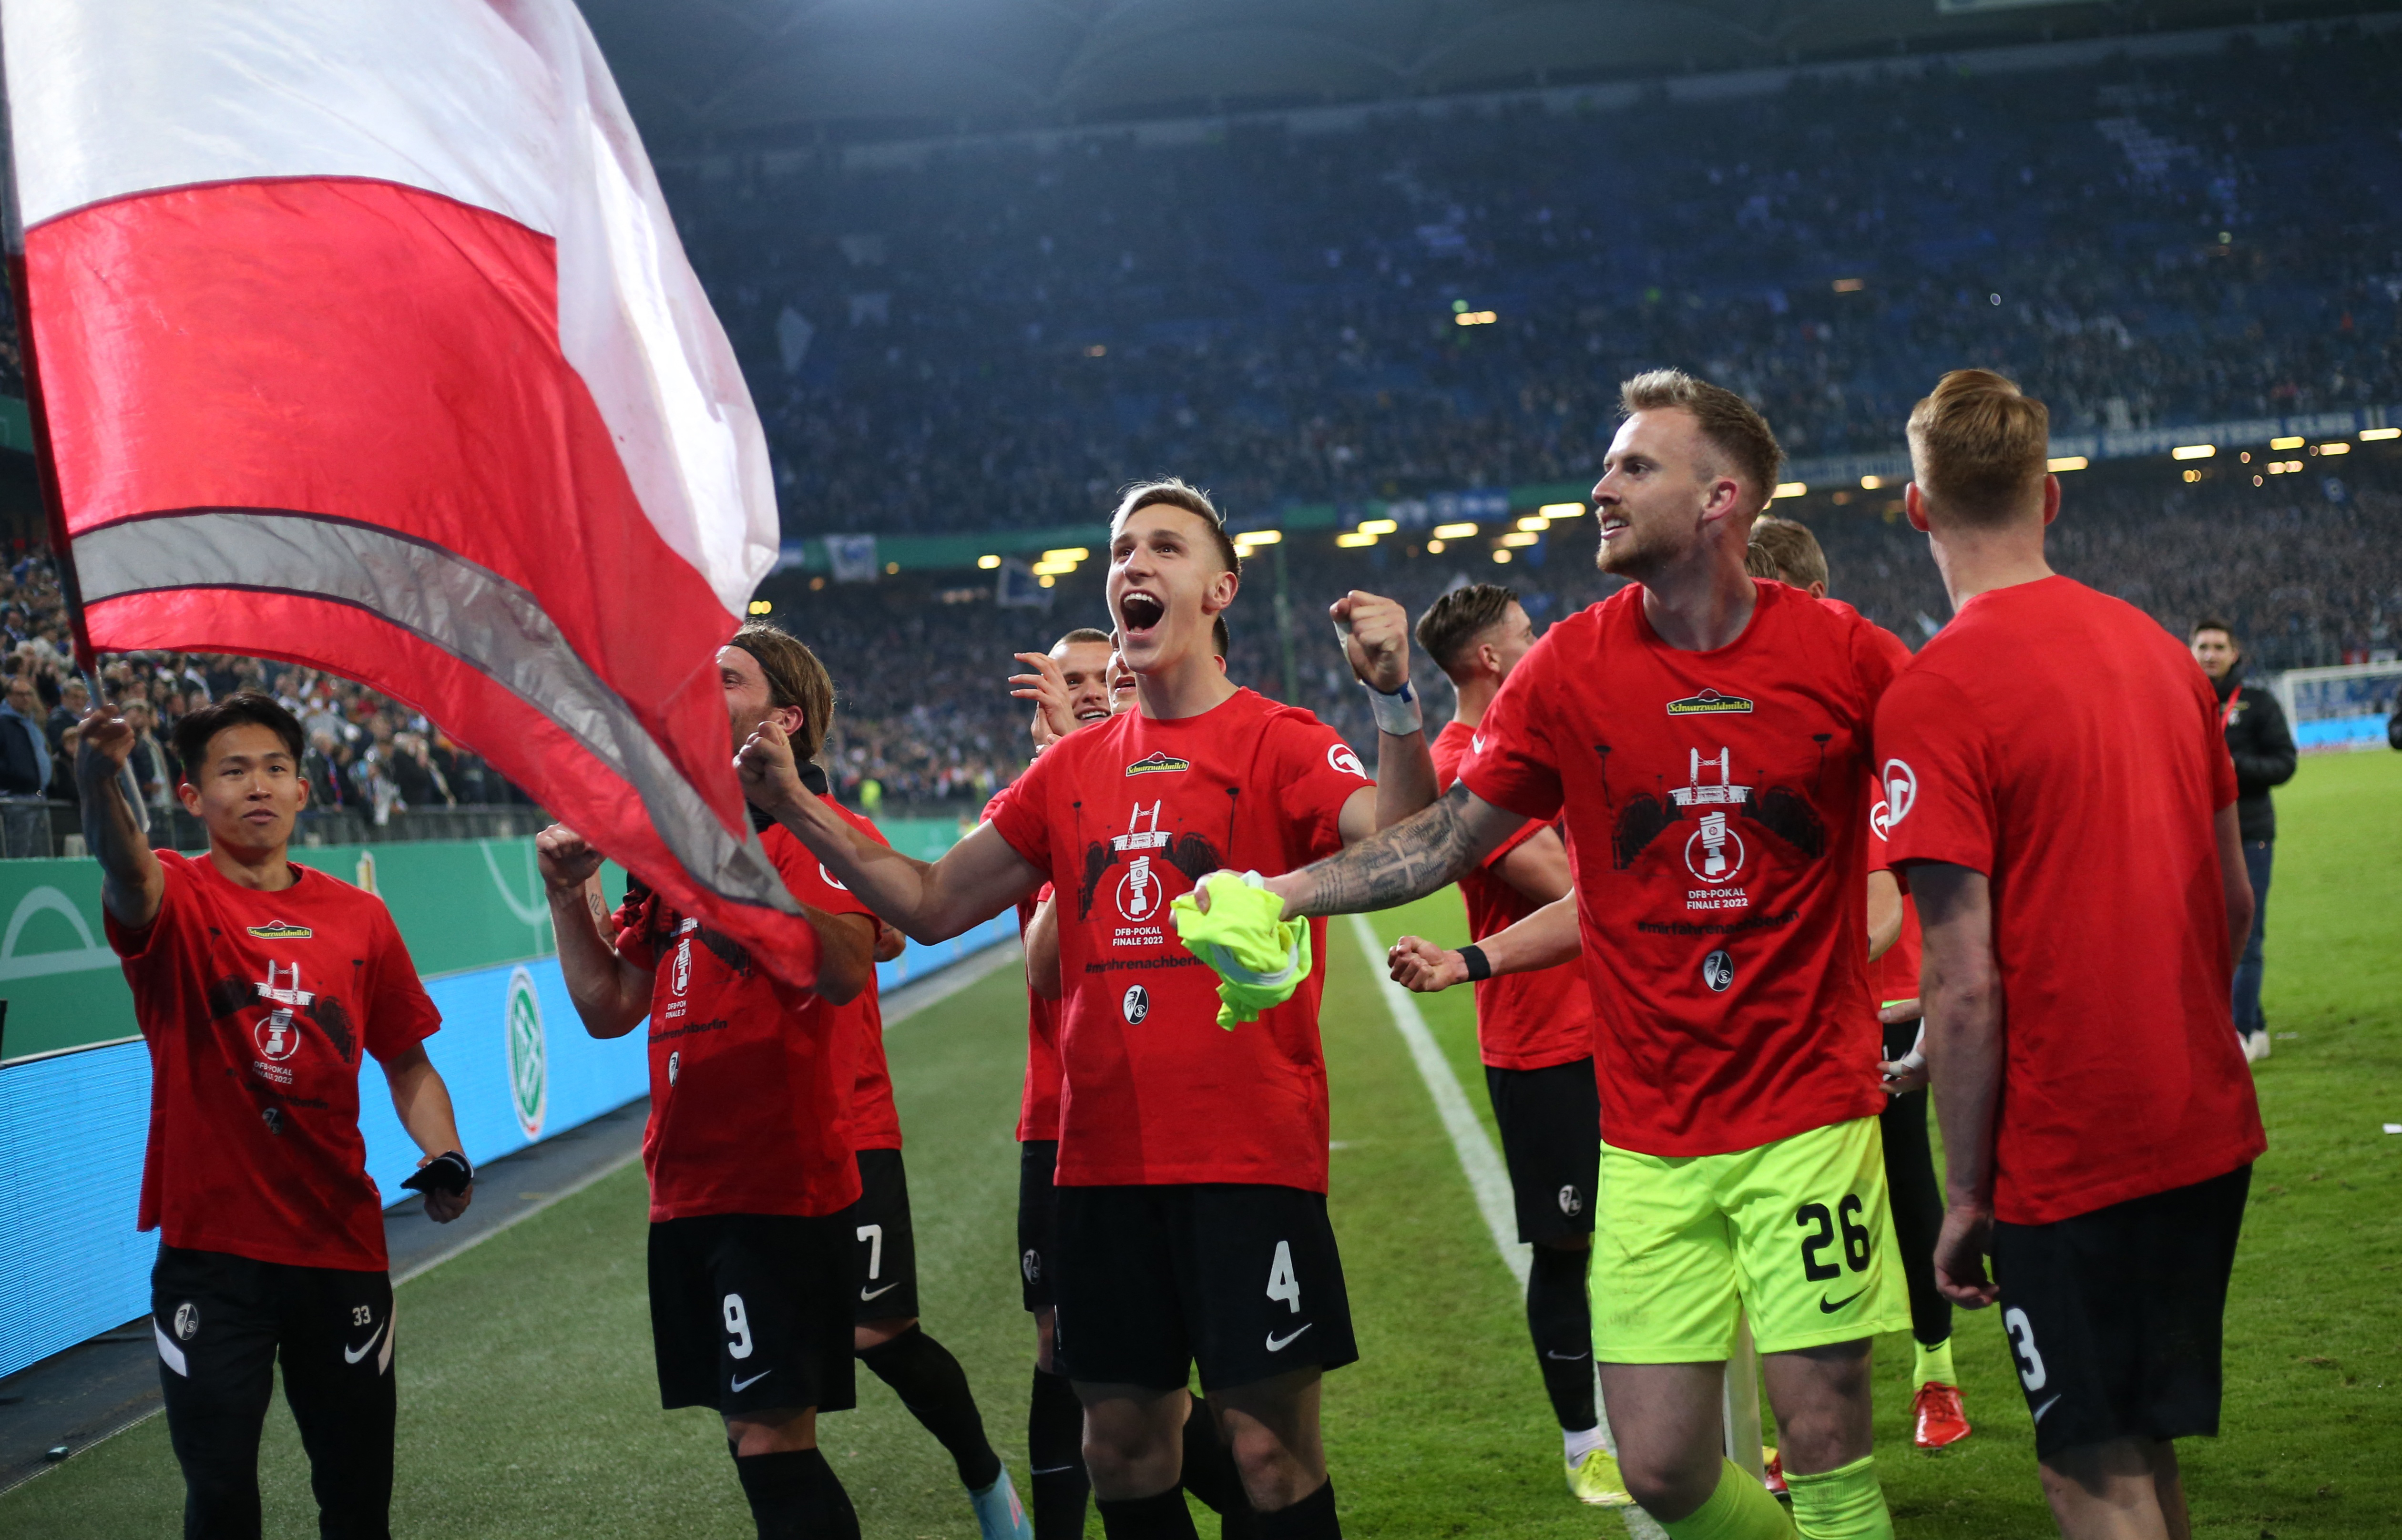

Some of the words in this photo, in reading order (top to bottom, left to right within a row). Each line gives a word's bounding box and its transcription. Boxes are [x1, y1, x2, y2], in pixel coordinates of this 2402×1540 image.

[1669, 701, 1750, 712] Schwarzwaldmilch
[1128, 762, 1186, 774] Schwarzwaldmilch
[1688, 887, 1746, 899] DFB-POKAL
[1687, 900, 1720, 909] FINALE
[1723, 898, 1748, 908] 2022
[1115, 926, 1162, 937] DFB-POKAL
[1112, 937, 1141, 946] FINALE
[1143, 936, 1164, 945] 2022
[274, 1075, 293, 1084] 2022
[1796, 1193, 1871, 1282] 26
[856, 1224, 882, 1280] 7
[1266, 1240, 1300, 1314] 4
[352, 1305, 372, 1326] 33
[723, 1293, 753, 1359] 9
[2005, 1307, 2047, 1392] 3
